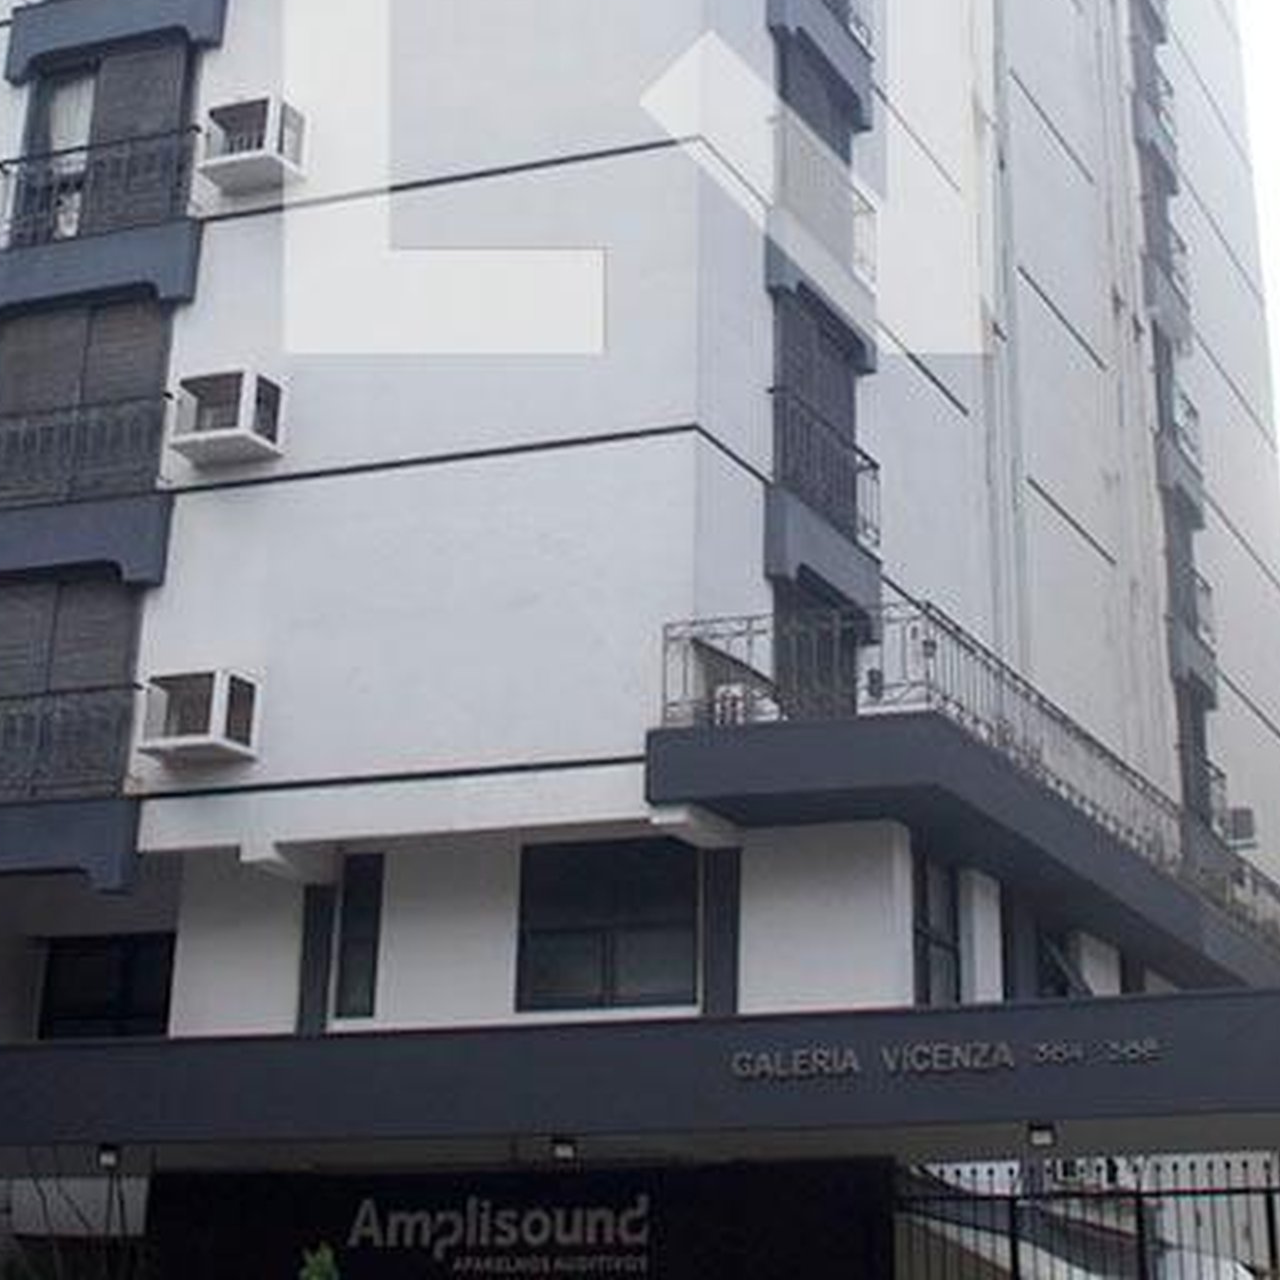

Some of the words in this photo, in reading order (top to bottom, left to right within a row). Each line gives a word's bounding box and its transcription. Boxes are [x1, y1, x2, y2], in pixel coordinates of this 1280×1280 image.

[730, 1046, 862, 1078] GALERIA
[880, 1040, 1016, 1072] VICENZA
[346, 1193, 651, 1262] Amplisound
